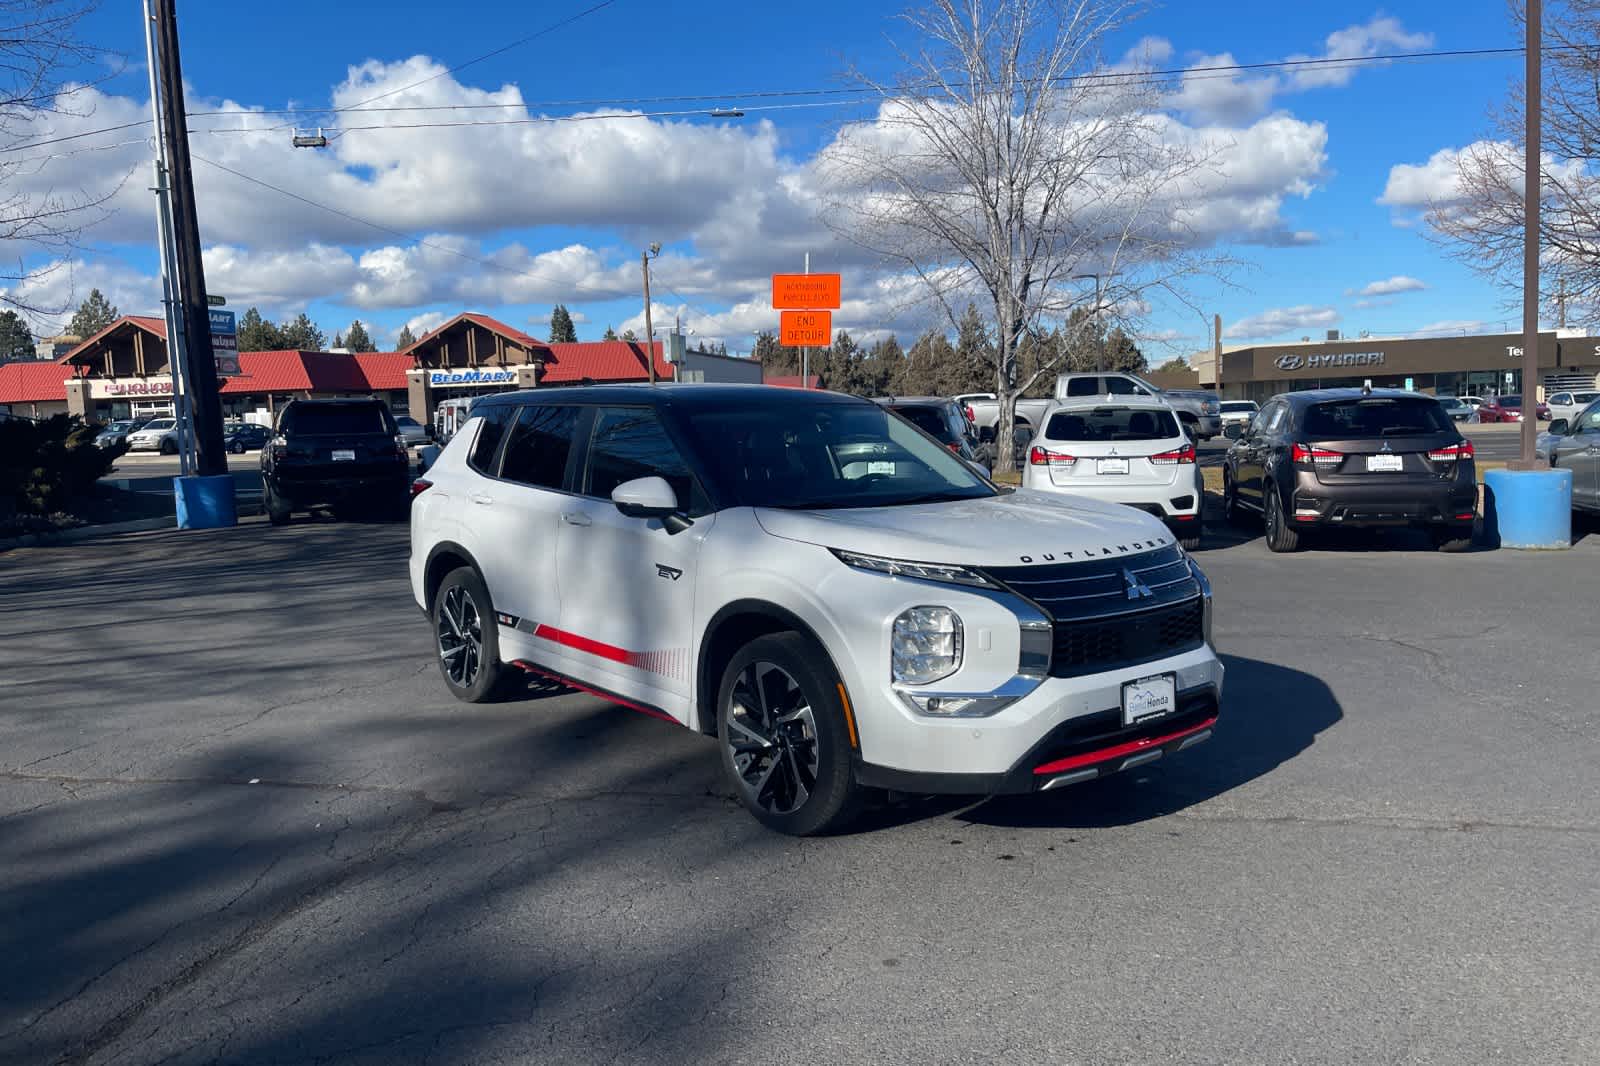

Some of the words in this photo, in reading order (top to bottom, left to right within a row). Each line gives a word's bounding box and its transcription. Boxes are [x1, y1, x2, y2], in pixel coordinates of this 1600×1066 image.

[797, 316, 815, 327] END
[788, 330, 824, 341] DETOUR
[1307, 352, 1385, 368] HYUNDAI
[1020, 537, 1167, 563] OUTLANDER
[1147, 695, 1169, 709] Honda
